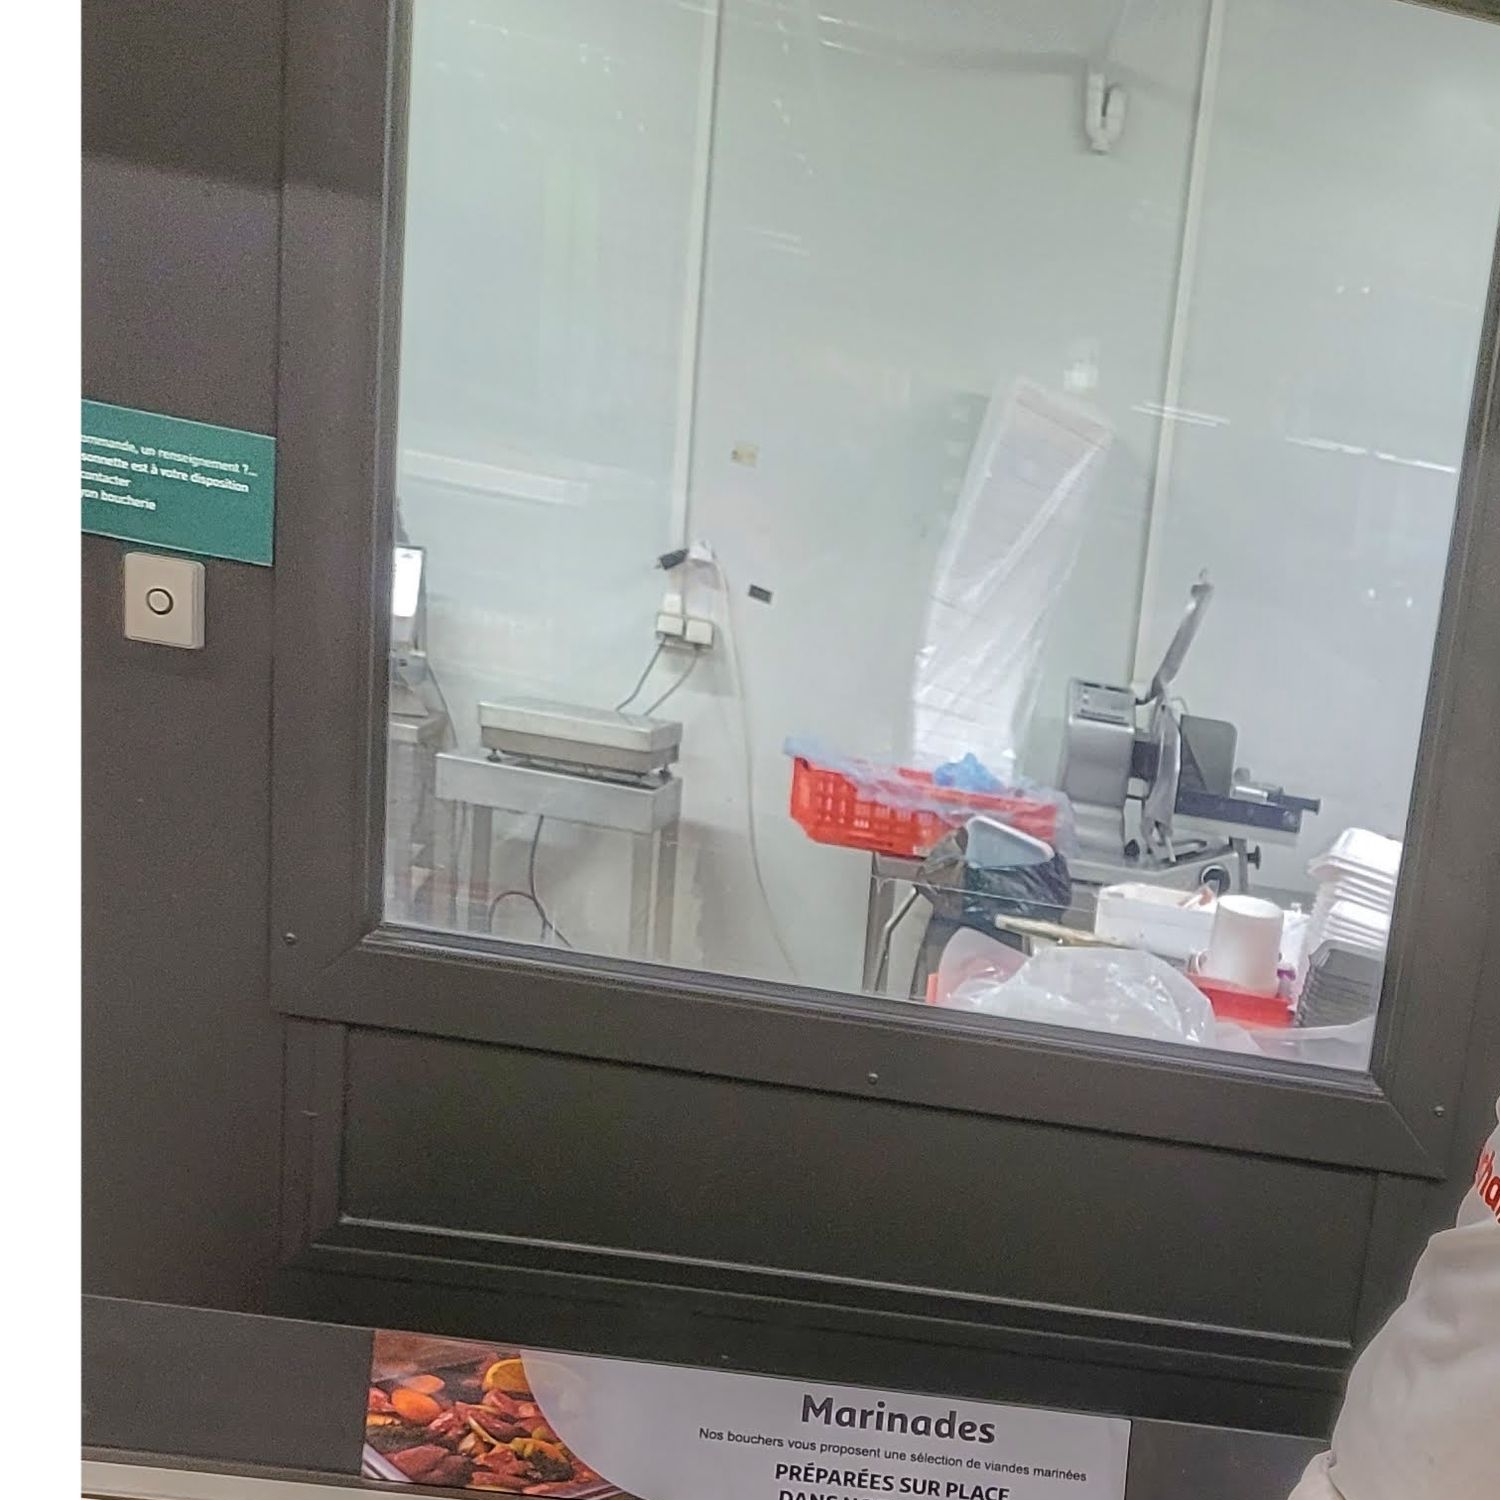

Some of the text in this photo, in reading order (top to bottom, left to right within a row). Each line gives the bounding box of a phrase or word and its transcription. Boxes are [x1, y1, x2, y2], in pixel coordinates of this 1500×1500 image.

[158, 449, 240, 473] renseignement
[160, 468, 189, 481] votre
[190, 472, 249, 493] disposition
[100, 489, 156, 511] boucherie
[801, 1394, 996, 1444] Marinades
[699, 1428, 1087, 1482] Nos bouchers vous proposent une sélection de viandes marinées
[775, 1462, 895, 1491] PRÉPARÉES
[899, 1477, 941, 1497] SUR
